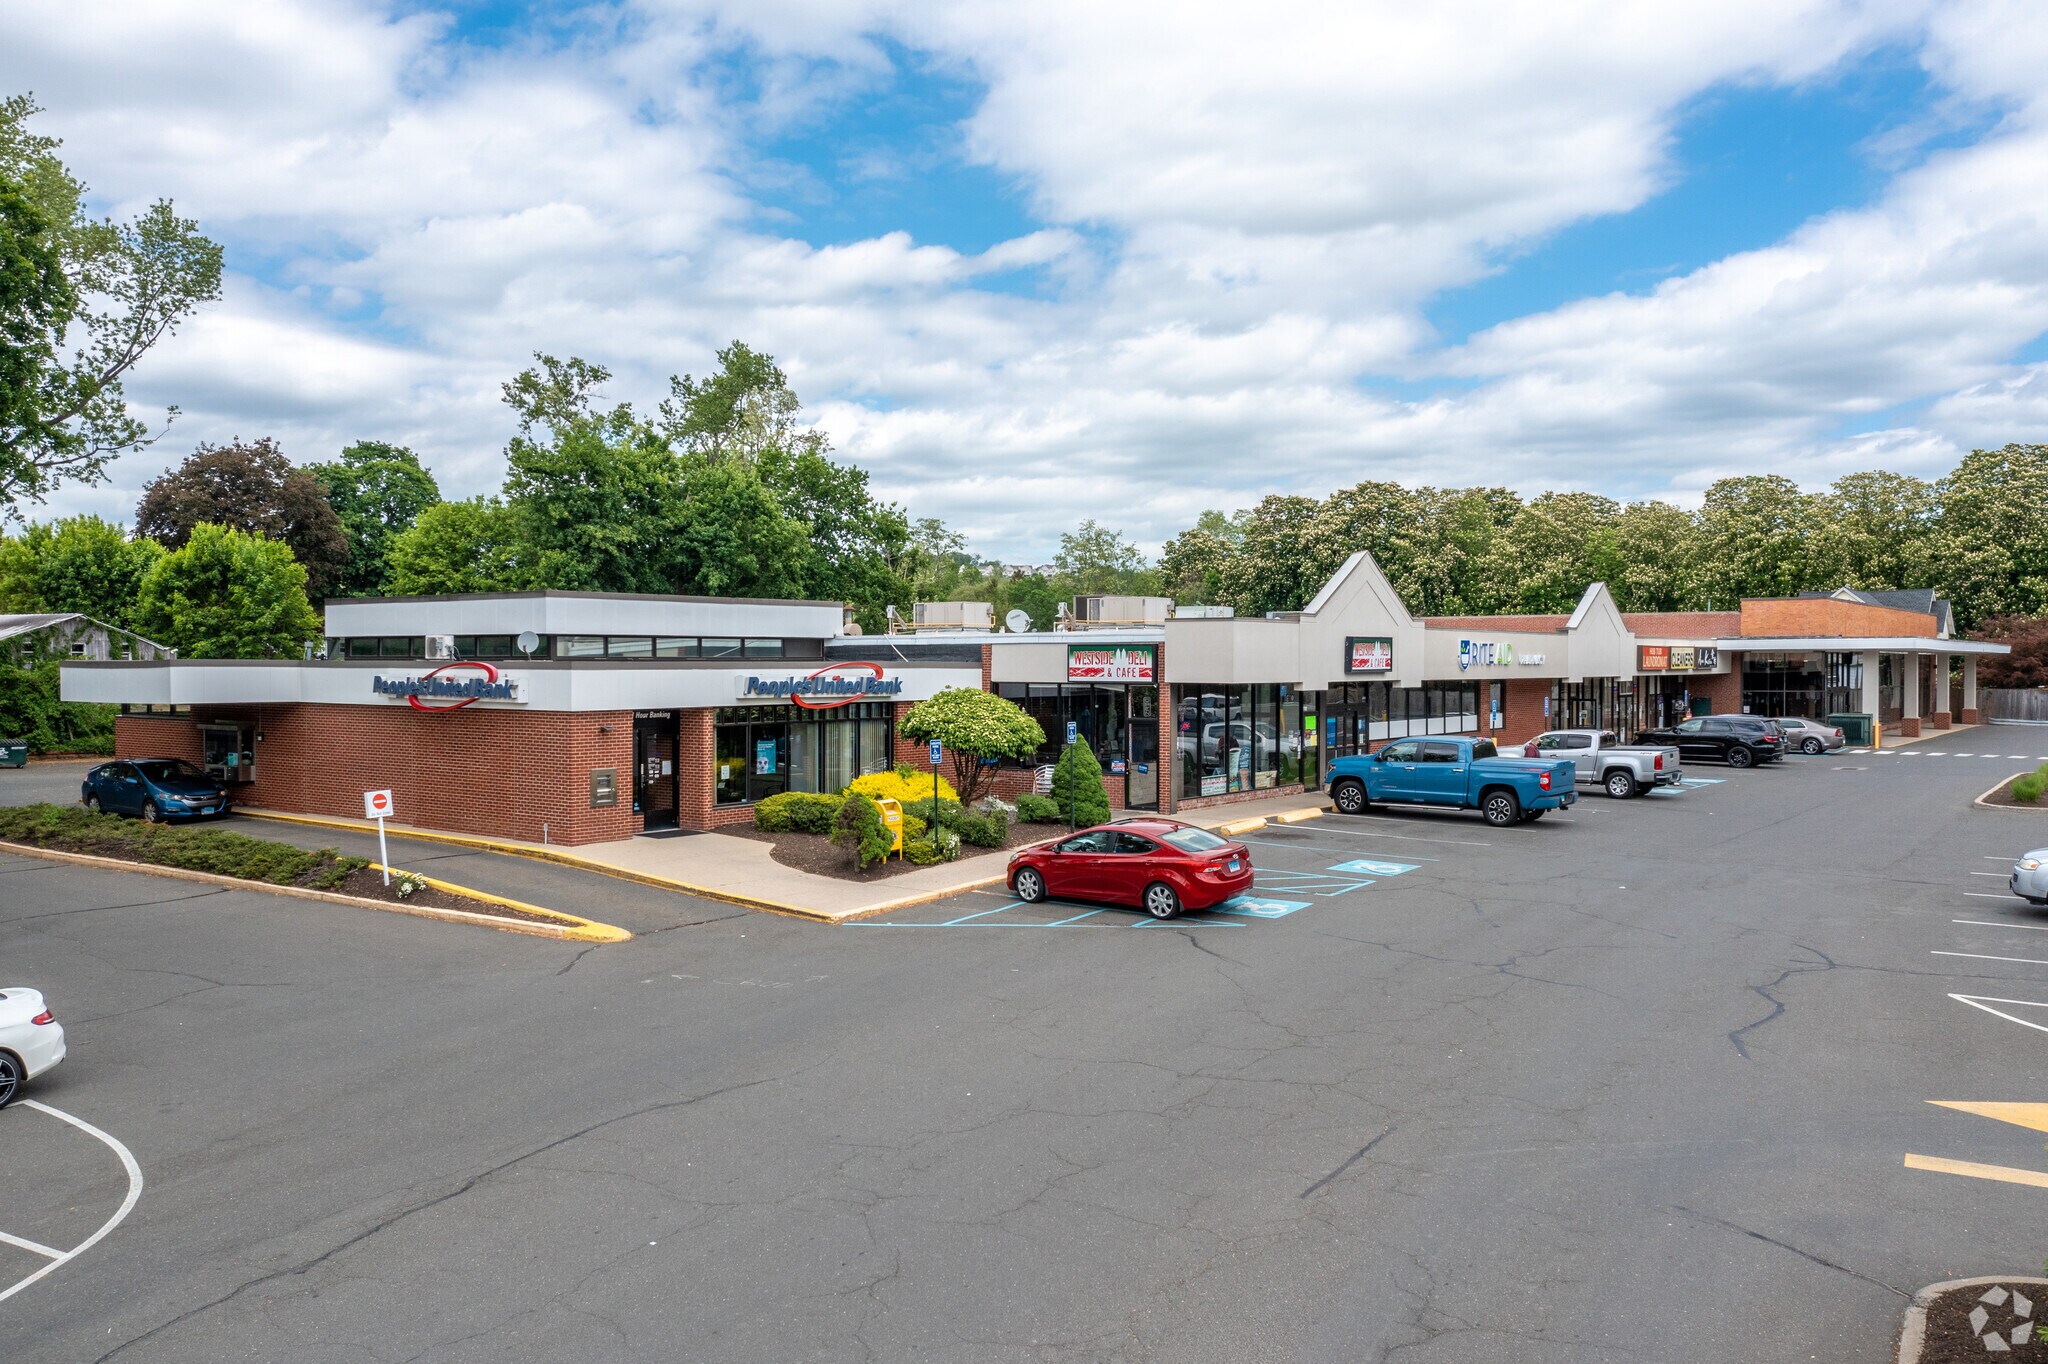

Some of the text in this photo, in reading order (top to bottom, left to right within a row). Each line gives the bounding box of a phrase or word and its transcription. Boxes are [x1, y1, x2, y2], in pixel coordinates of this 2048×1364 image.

[1073, 650, 1148, 666] WESTSIDE DELI
[1472, 642, 1494, 664] RITE
[1495, 643, 1513, 665] AID
[1671, 652, 1693, 667] CLEANERS
[1107, 667, 1136, 677] & CAFE
[373, 675, 515, 699] People's United Bank
[746, 675, 902, 699] People's United Bank
[635, 710, 671, 719] Hour Banking
